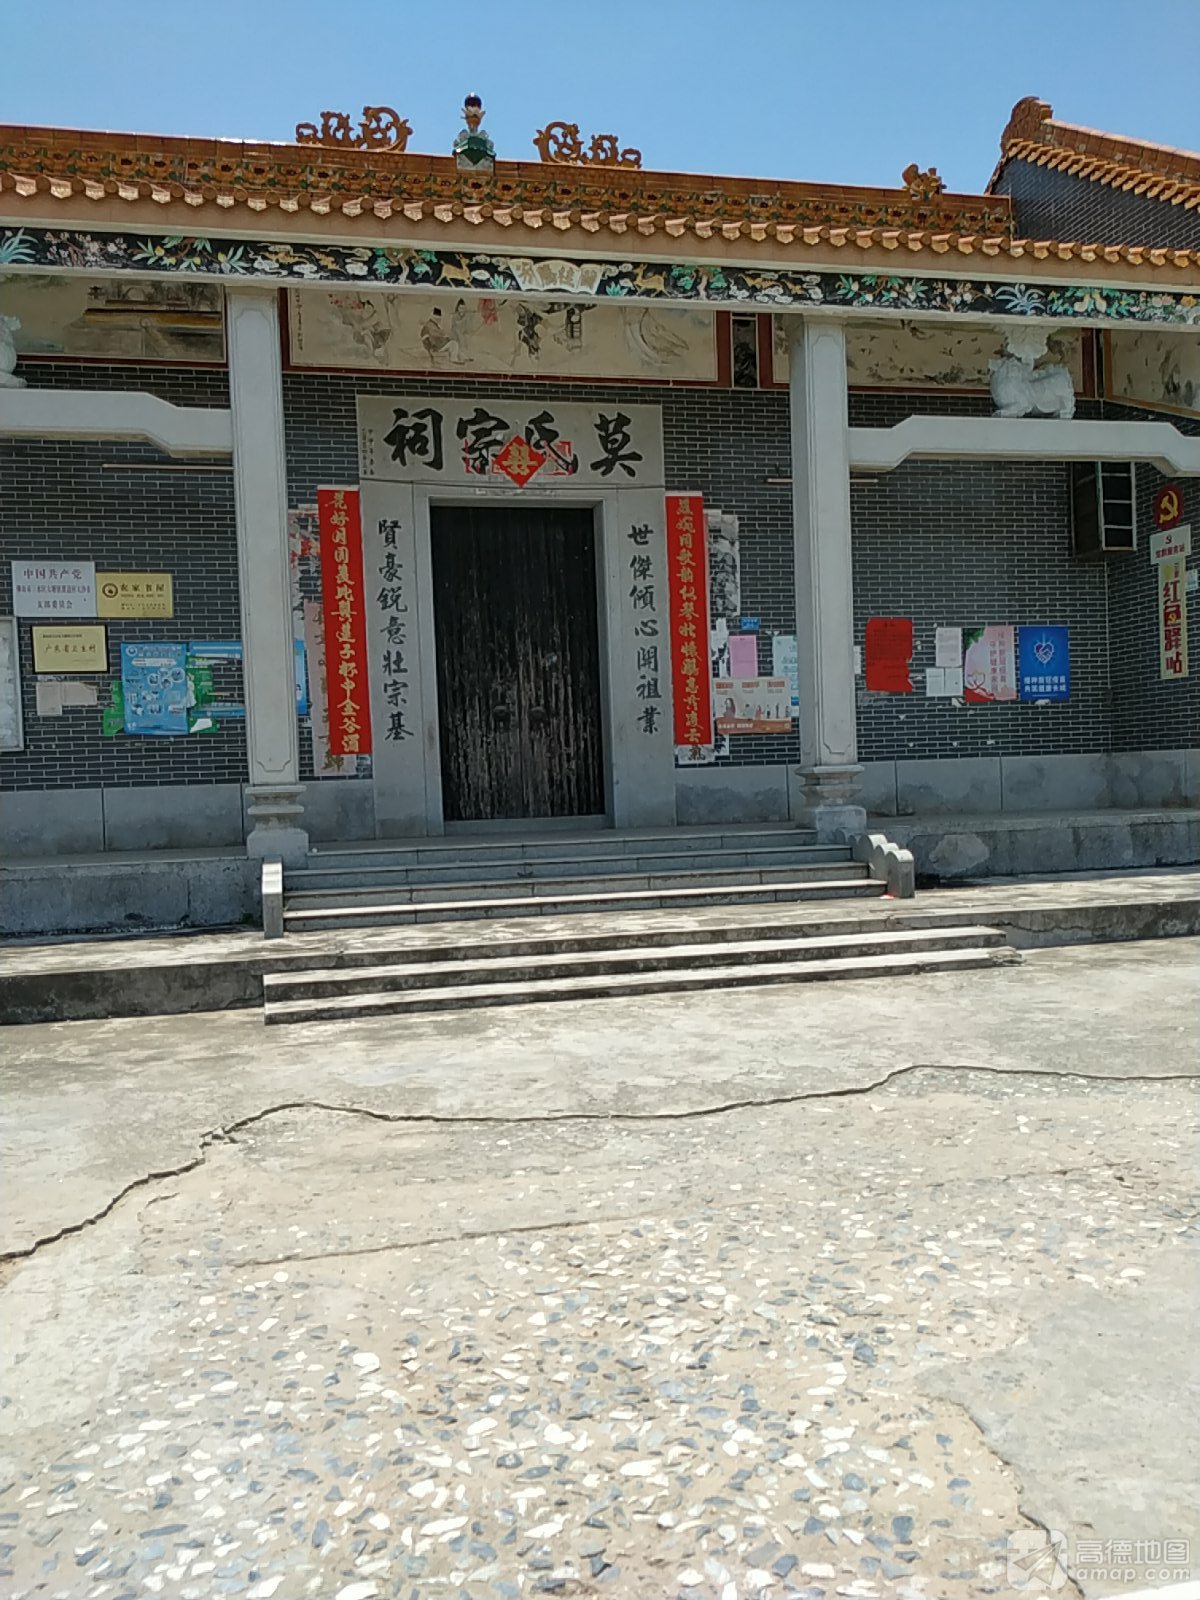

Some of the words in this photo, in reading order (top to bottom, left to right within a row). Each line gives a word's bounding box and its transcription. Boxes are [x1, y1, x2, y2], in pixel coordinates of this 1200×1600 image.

[23, 568, 83, 580] 中国共产党
[120, 583, 166, 593] 农家书屋
